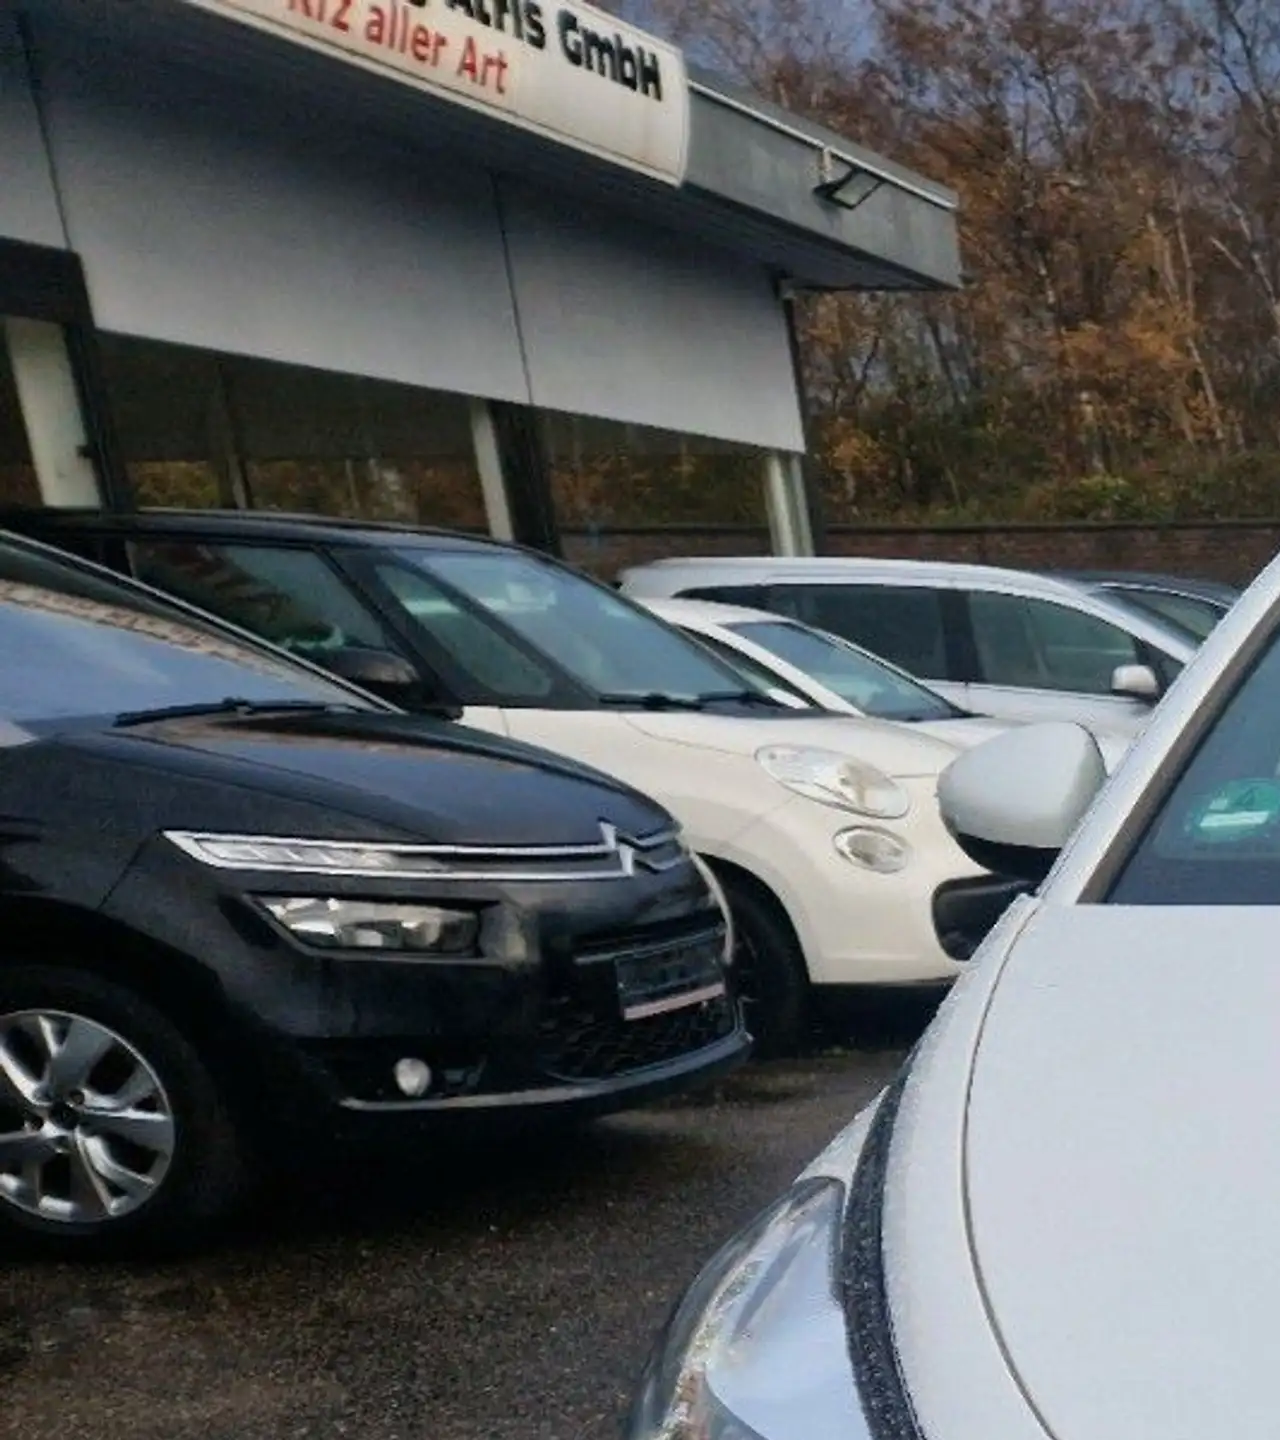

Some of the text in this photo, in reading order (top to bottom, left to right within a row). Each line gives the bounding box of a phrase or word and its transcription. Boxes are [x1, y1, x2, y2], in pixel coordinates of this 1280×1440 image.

[366, 0, 446, 67] aller
[457, 35, 508, 95] Art
[558, 8, 663, 101] GmbH
